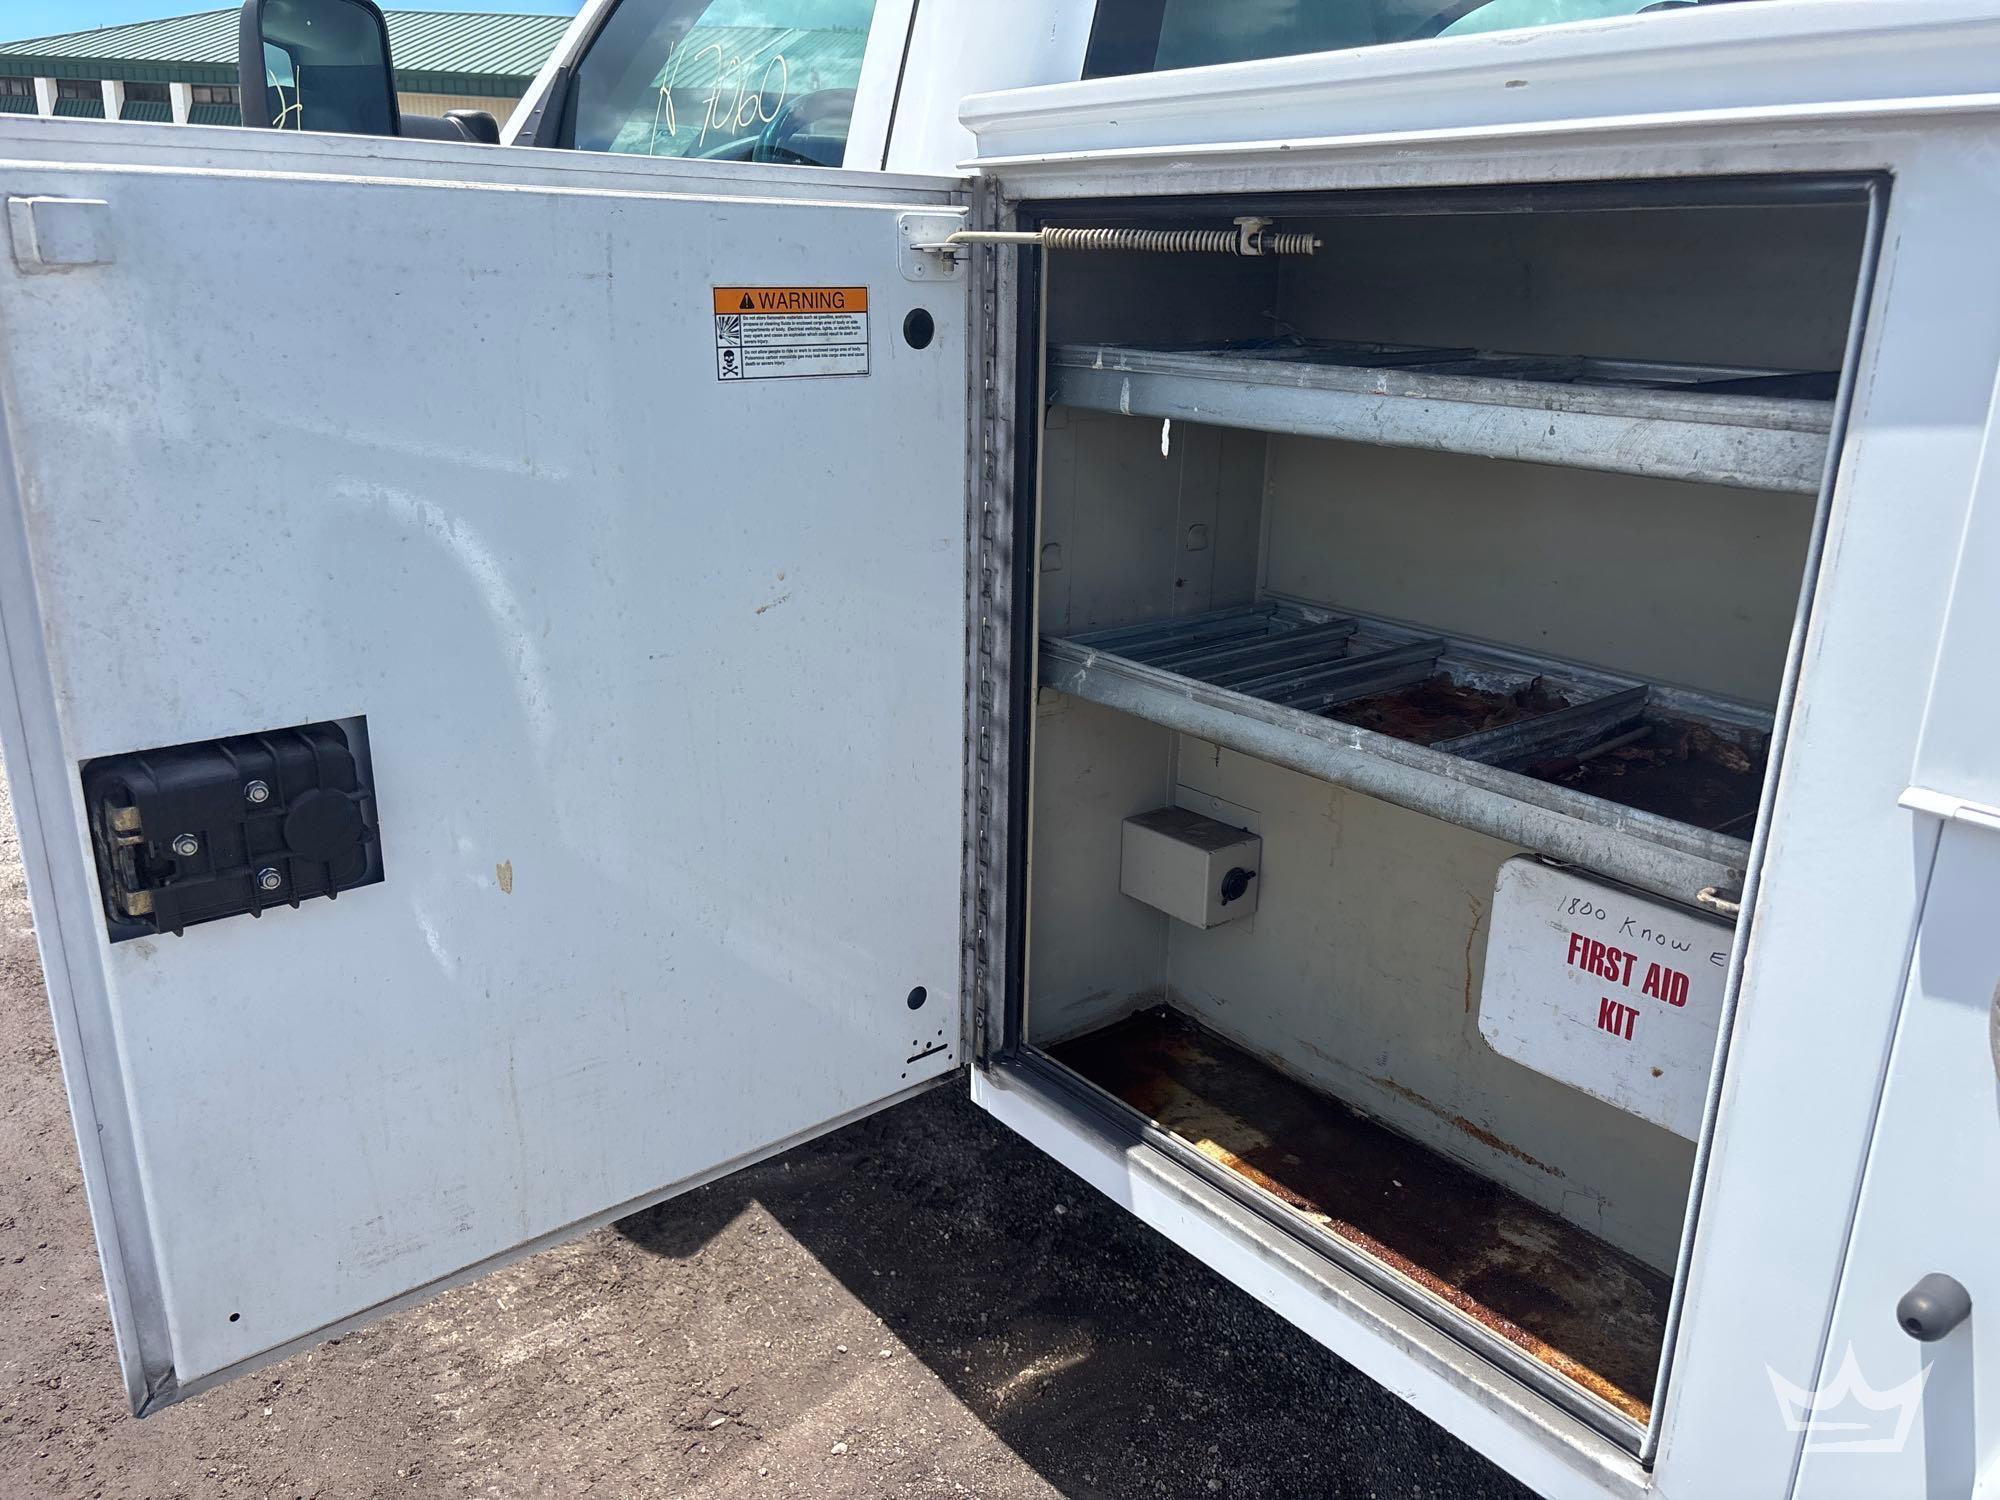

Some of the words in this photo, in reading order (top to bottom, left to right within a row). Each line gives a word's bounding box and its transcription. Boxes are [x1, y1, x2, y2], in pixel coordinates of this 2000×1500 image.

[758, 291, 845, 310] WARNING
[1557, 895, 1606, 921] 1800
[1566, 931, 1639, 988] FIRST
[1641, 961, 1690, 1008] AID
[1597, 996, 1641, 1042] KIT
